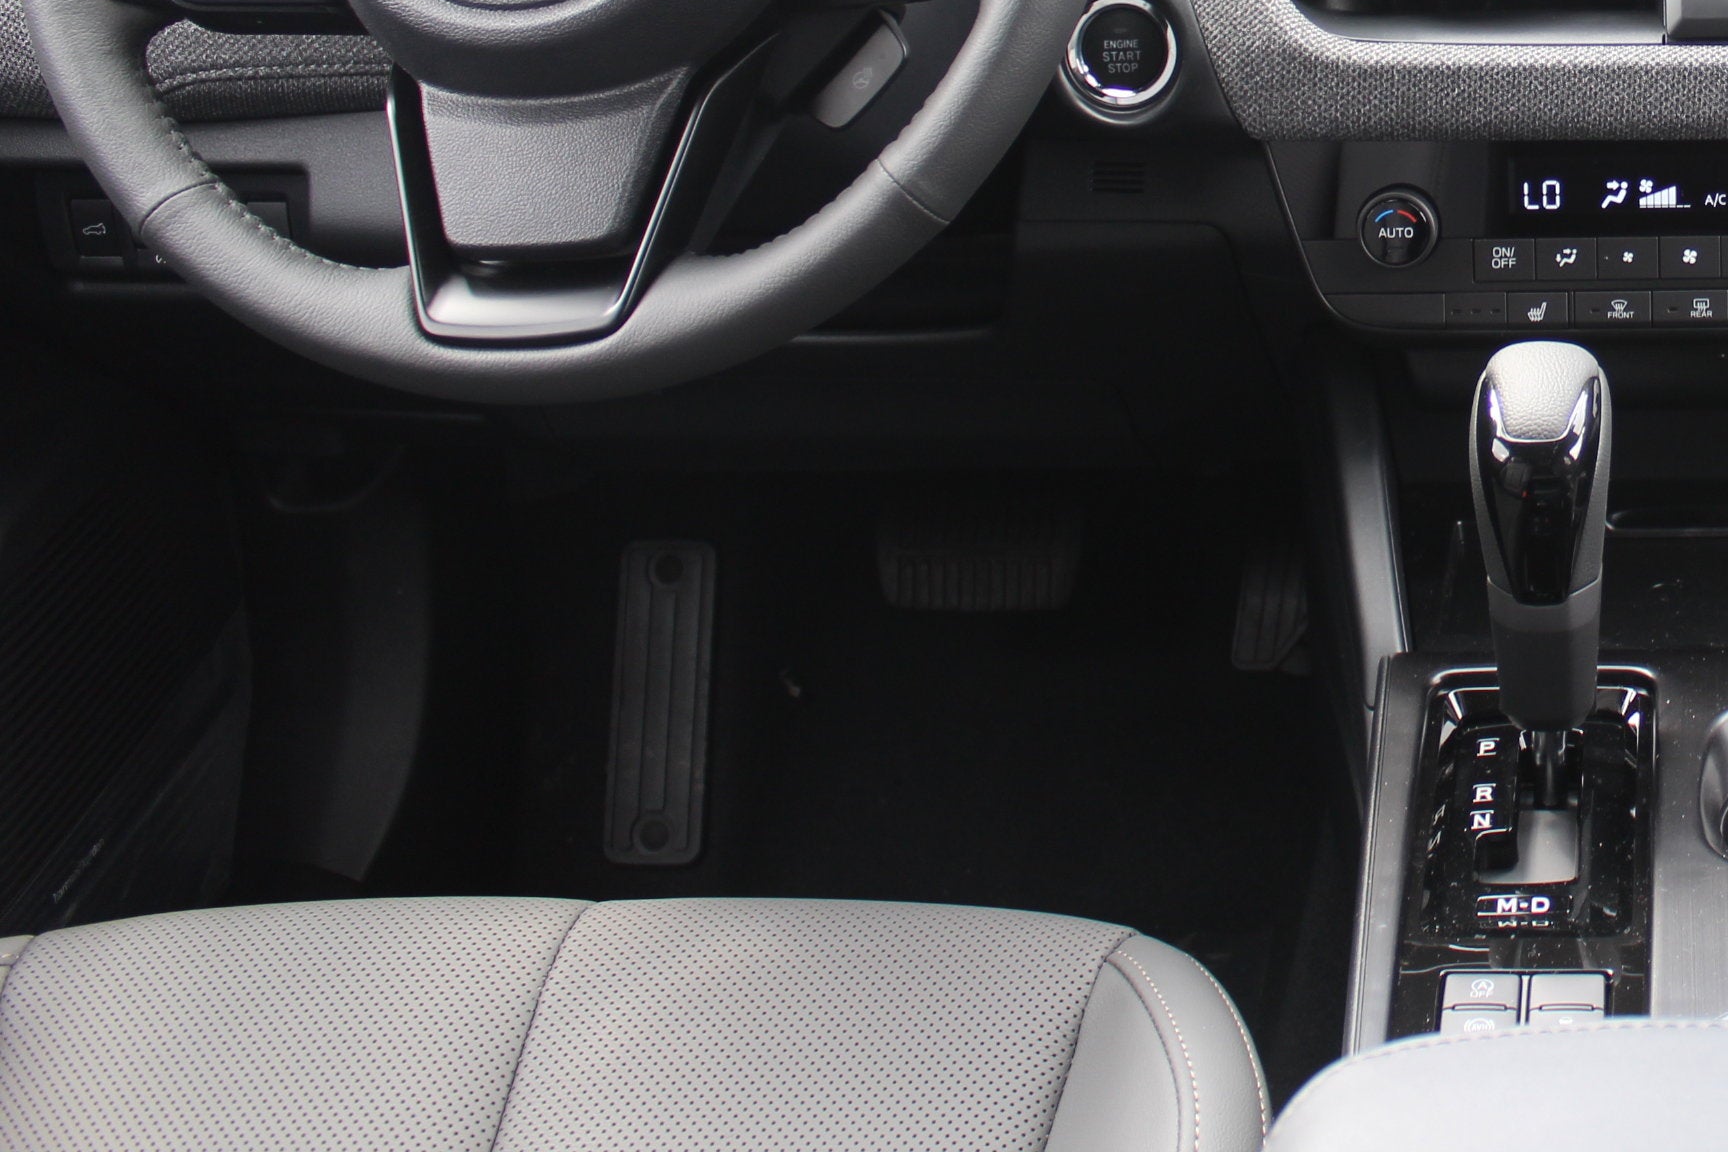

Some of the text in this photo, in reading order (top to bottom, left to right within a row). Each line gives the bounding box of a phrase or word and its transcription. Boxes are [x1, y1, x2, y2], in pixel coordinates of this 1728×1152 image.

[1103, 39, 1139, 49] ENGINE
[1102, 51, 1142, 62] START
[1108, 63, 1138, 74] STOP
[1704, 193, 1727, 207] A/C
[1378, 226, 1414, 239] AUTO
[1492, 246, 1515, 259] ON/
[1491, 257, 1517, 269] OFF
[1607, 311, 1634, 319] FRONT
[1690, 310, 1713, 318] REAR
[1475, 786, 1493, 801] R
[1473, 813, 1492, 828] N
